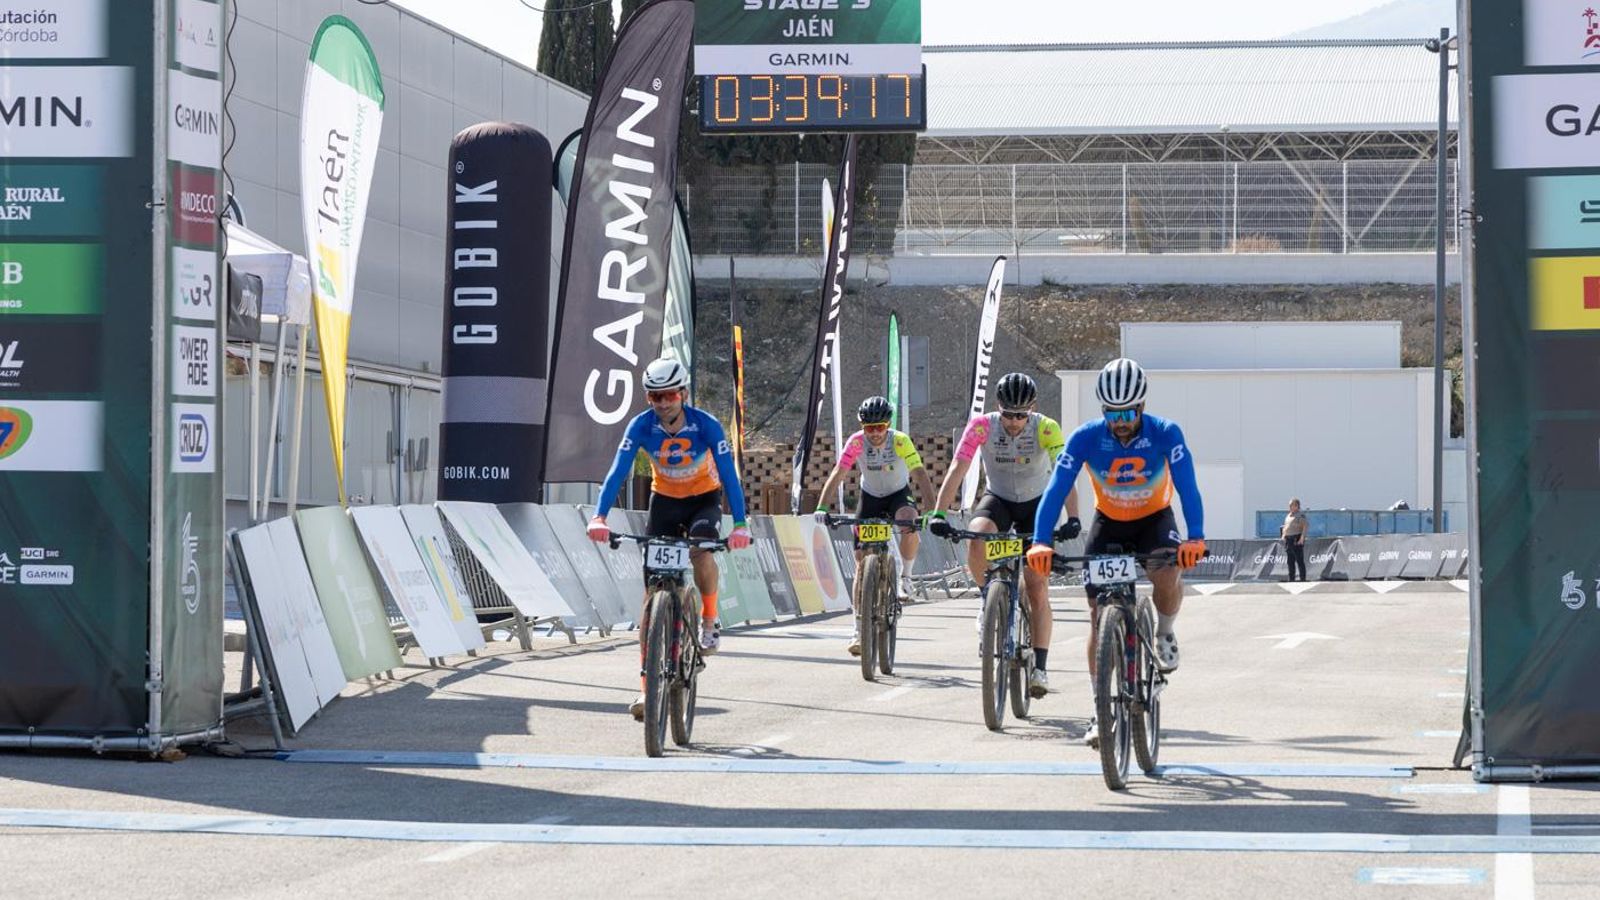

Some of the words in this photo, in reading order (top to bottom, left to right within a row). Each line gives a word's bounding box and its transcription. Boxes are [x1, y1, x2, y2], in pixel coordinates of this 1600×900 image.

[783, 14, 834, 37] JAÉN
[769, 53, 850, 66] GARMIN
[714, 74, 911, 122] 03:39:17
[175, 104, 218, 135] GRMIN
[5, 187, 65, 202] RURAL
[453, 180, 498, 345] GOBIK
[583, 86, 660, 425] GARMIN
[2, 262, 23, 284] B
[0, 340, 24, 368] L
[180, 337, 208, 361] OWER
[187, 362, 208, 385] ADE
[444, 466, 510, 480] GOBIK.COM
[861, 525, 890, 539] 201-1
[655, 547, 682, 565] 45-1
[988, 540, 1020, 557] 201-2
[1254, 554, 1287, 564] GARMI
[26, 570, 68, 579] GARMIN
[1098, 559, 1129, 580] 45-2
